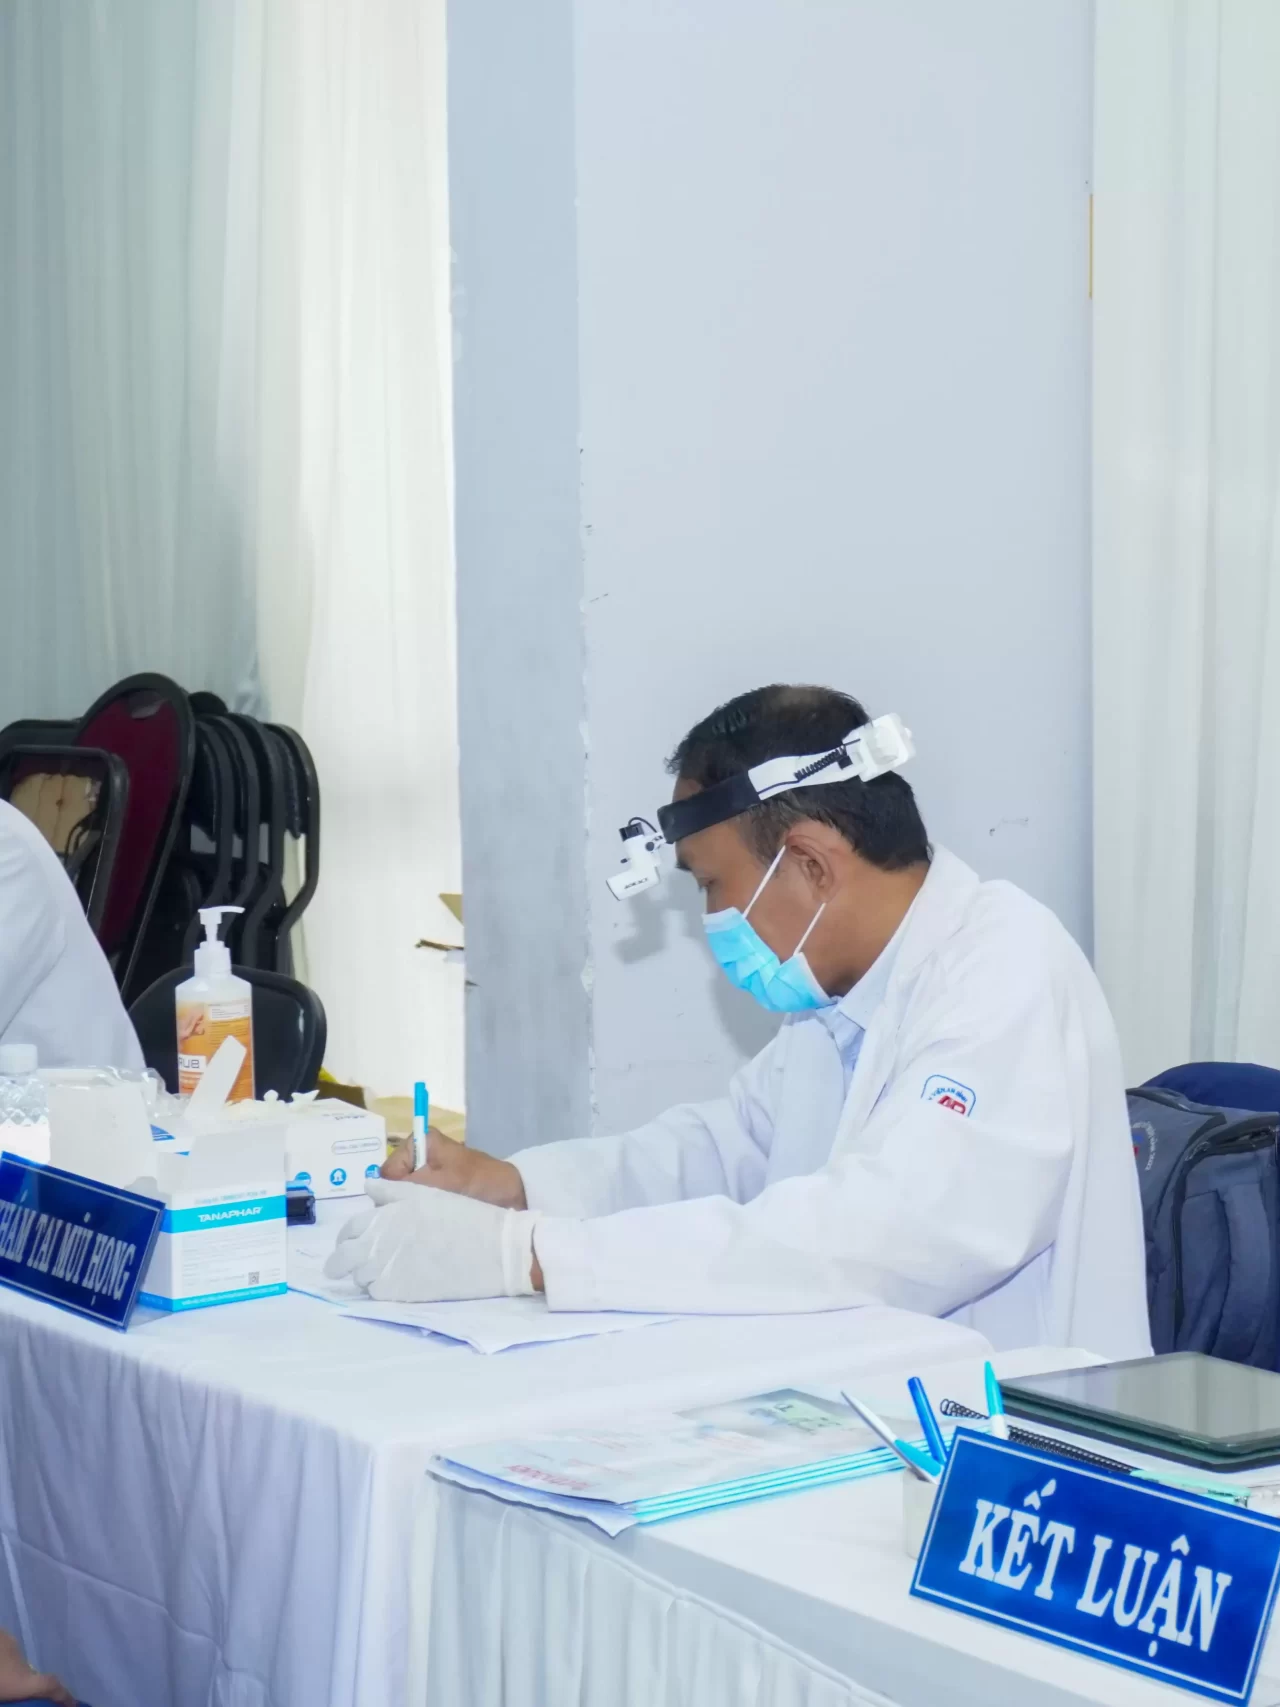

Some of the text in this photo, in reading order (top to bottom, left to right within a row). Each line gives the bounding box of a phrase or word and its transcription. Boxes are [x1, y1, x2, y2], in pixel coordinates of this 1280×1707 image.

[27, 1213, 63, 1273] TAI
[958, 1478, 1233, 1658] KẾT LUẬN
